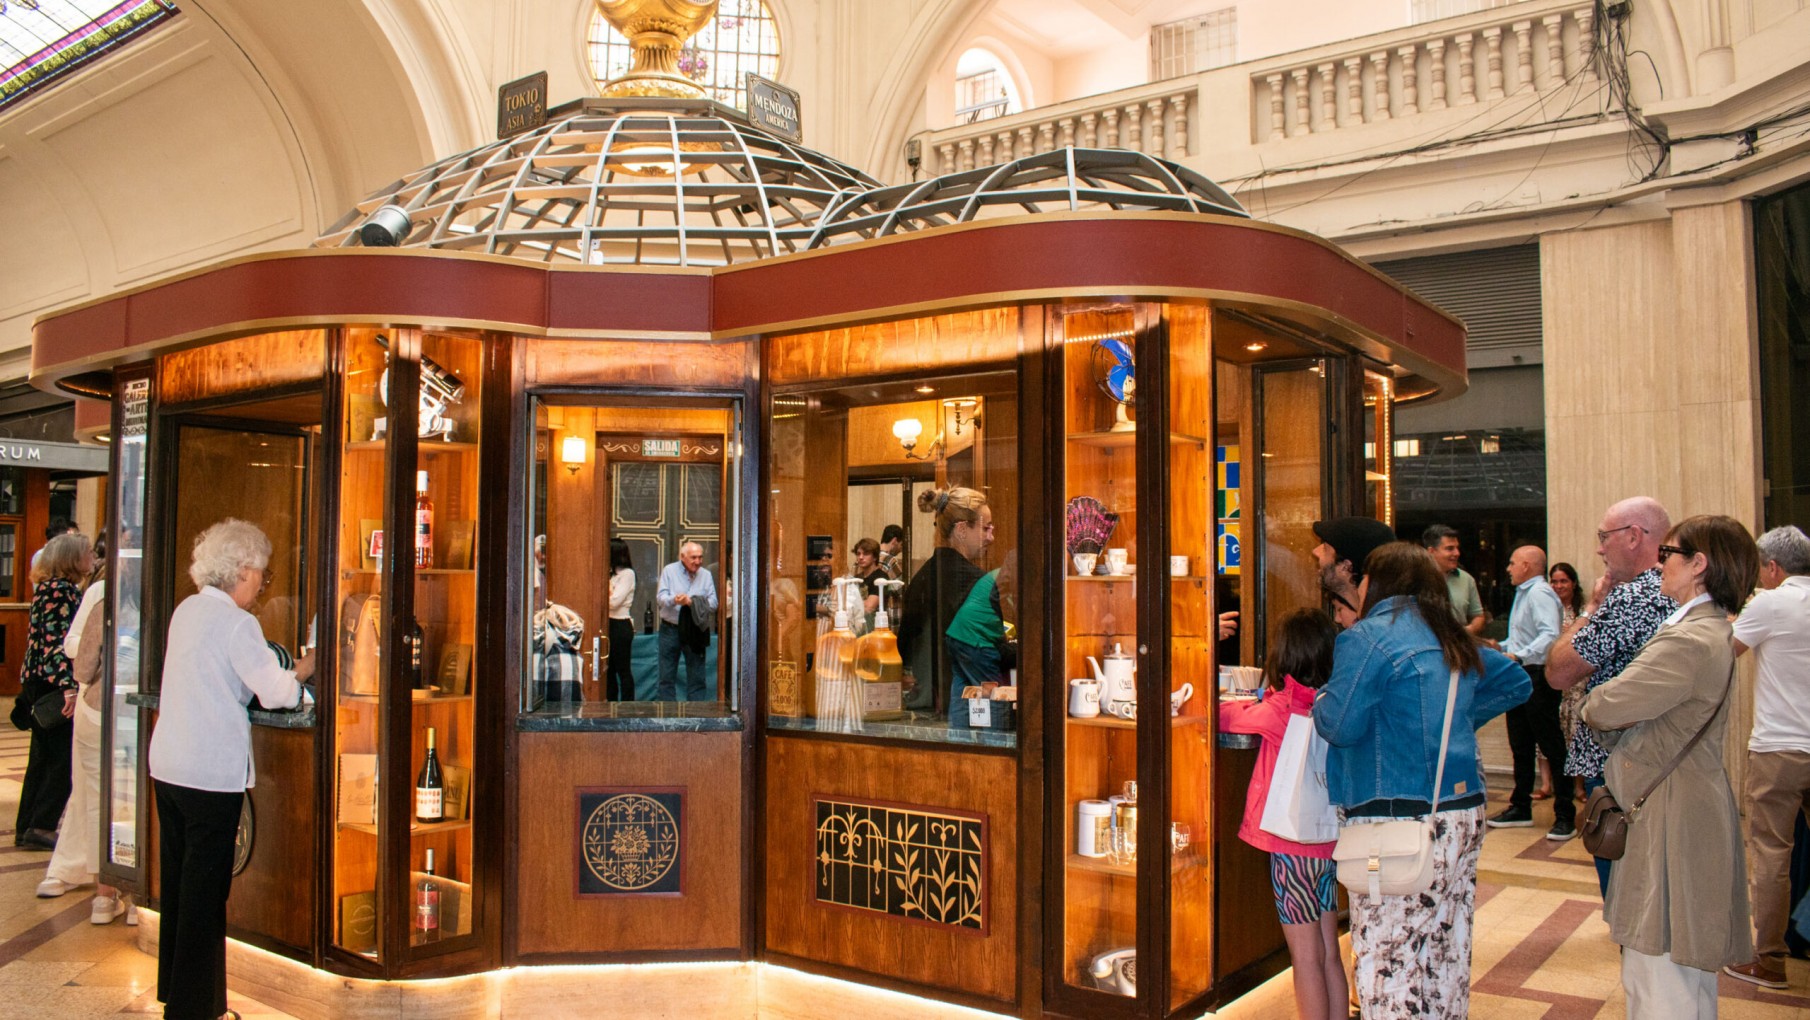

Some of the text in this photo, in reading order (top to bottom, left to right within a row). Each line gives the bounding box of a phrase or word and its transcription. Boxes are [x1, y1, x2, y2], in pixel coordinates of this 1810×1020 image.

[505, 88, 539, 112] TOKIO
[754, 93, 798, 122] MENDOZA
[507, 114, 525, 130] ASIA
[644, 440, 678, 452] SALIDA
